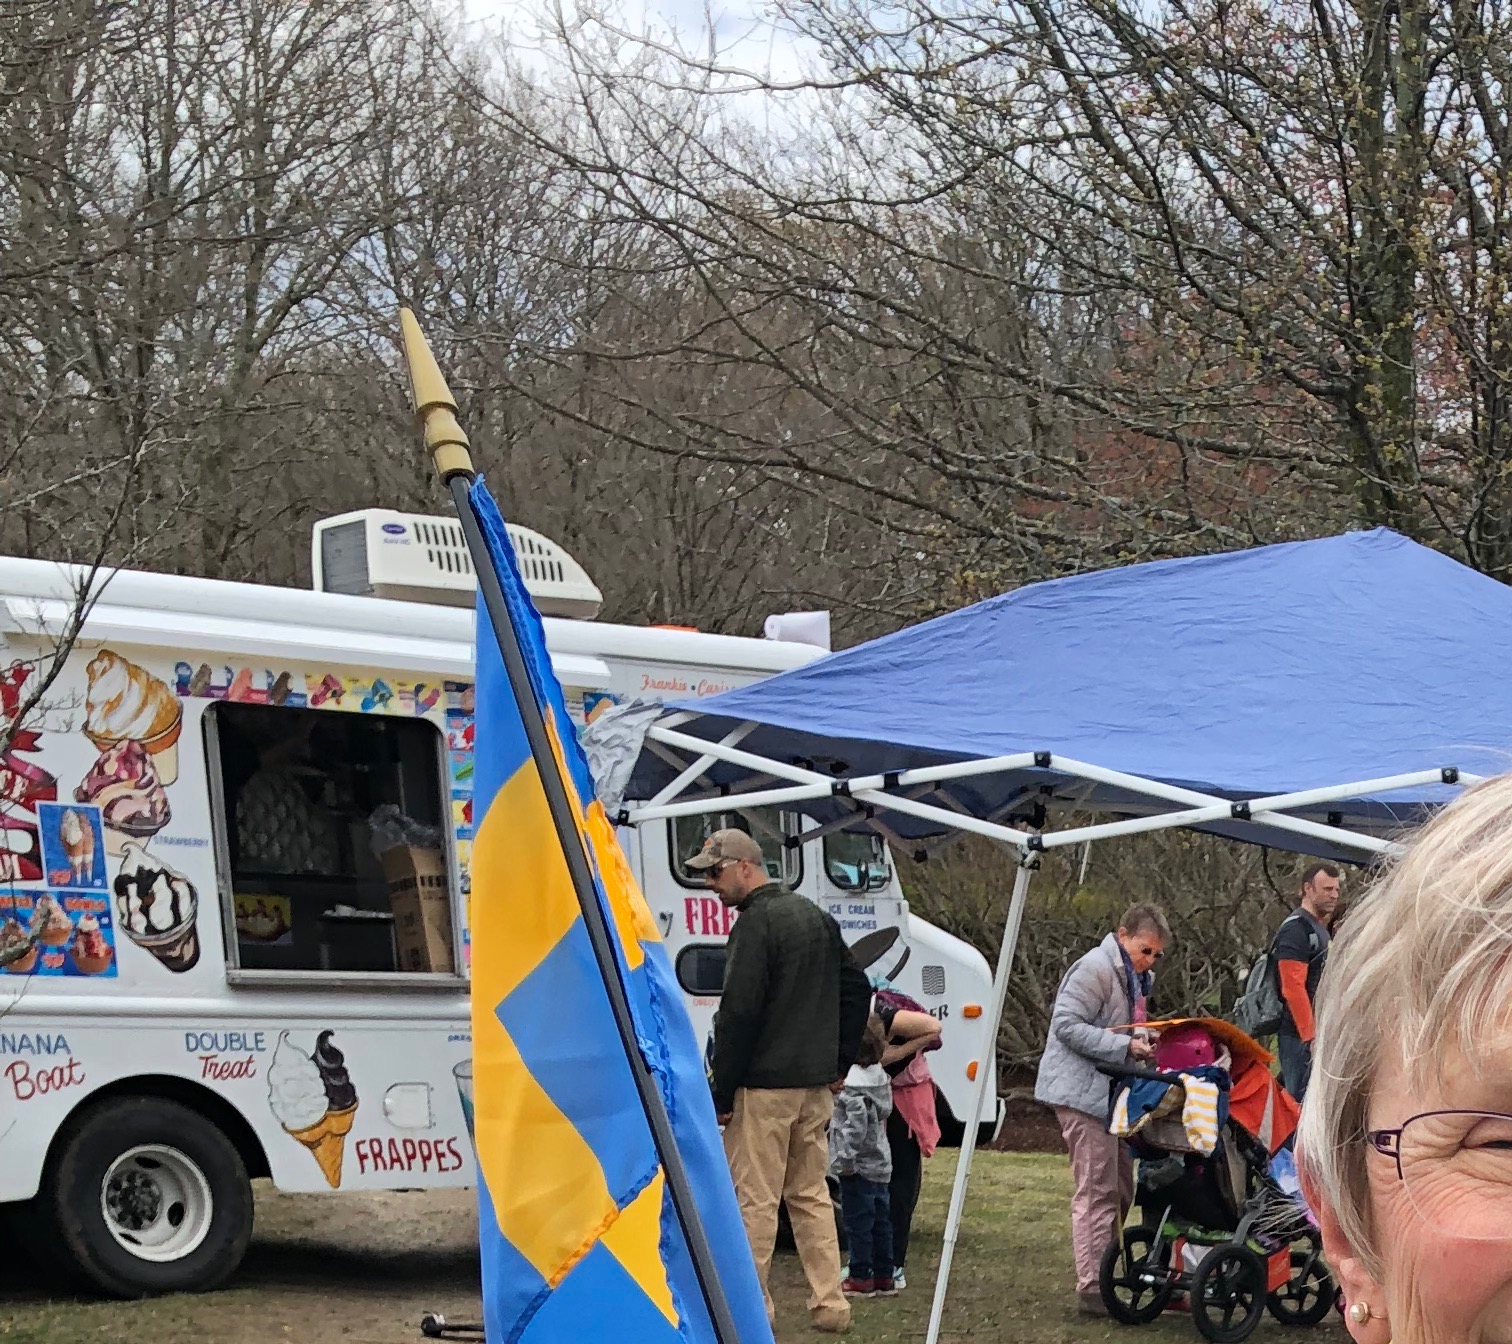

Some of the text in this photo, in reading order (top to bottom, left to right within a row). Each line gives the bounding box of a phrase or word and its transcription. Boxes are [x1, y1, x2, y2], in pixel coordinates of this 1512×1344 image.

[640, 674, 688, 691] Frankie
[828, 904, 875, 916] ICE CREAM
[839, 919, 877, 930] DWICHES
[0, 1033, 72, 1055] NANA
[184, 1032, 267, 1052] DOUBLE
[198, 1054, 257, 1081] Treat
[4, 1056, 87, 1101] Boat
[355, 1136, 463, 1175] FRAPPES
